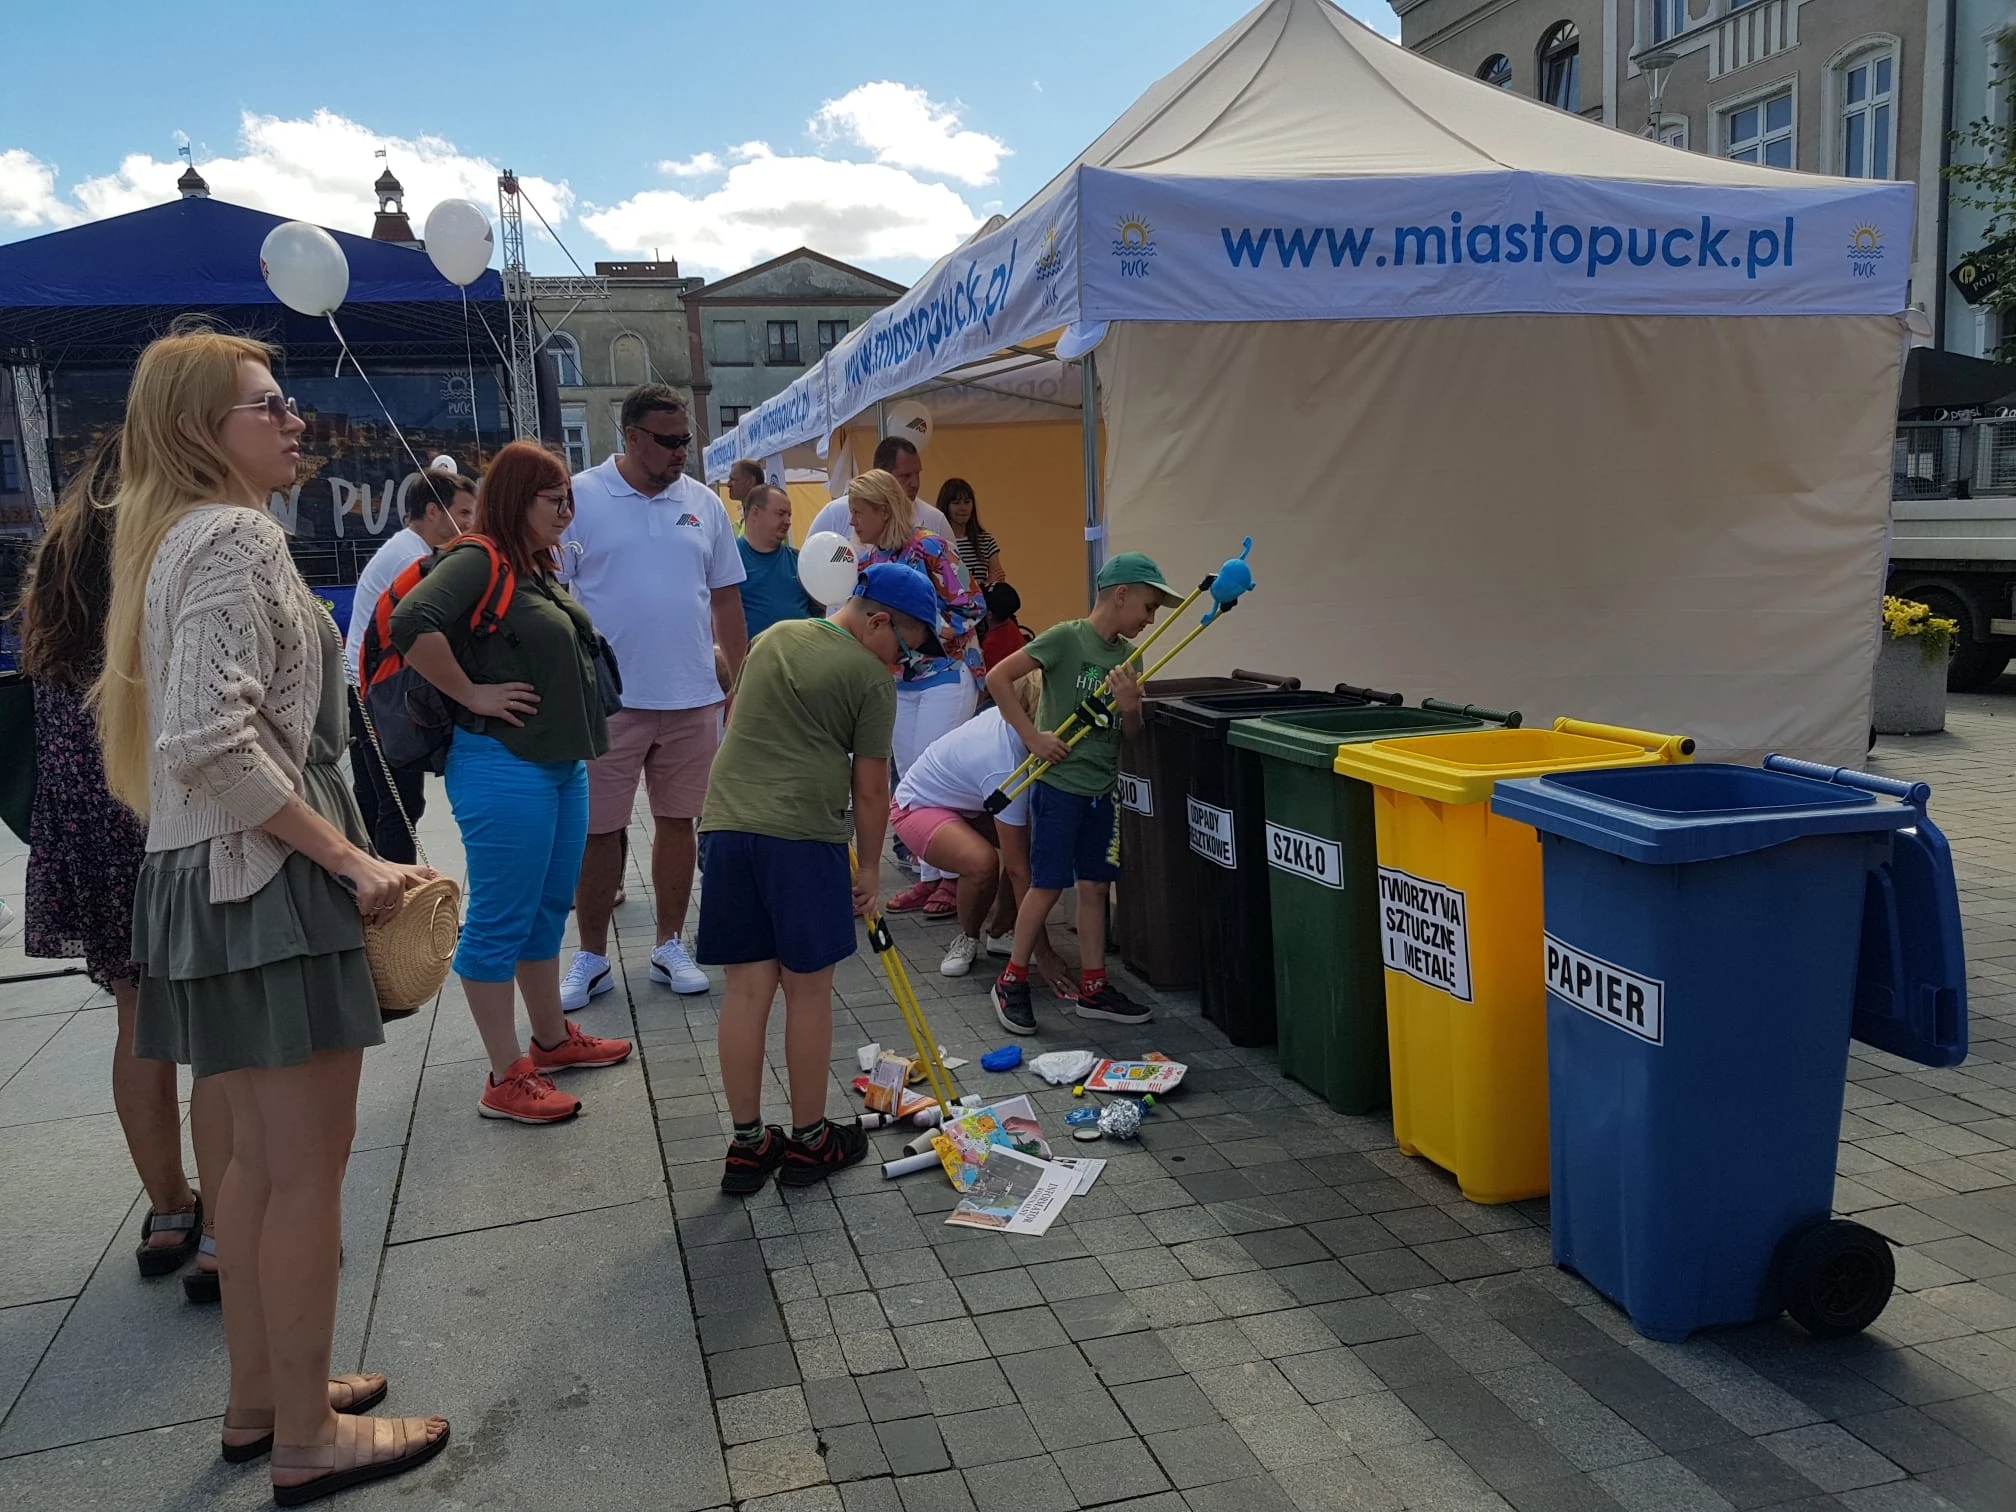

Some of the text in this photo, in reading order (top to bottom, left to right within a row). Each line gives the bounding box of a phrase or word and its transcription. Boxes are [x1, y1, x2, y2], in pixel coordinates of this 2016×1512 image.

[1120, 258, 1150, 279] PUCK
[1220, 210, 1795, 280] www.miastopuck.pl
[1852, 260, 1877, 279] PUCK
[843, 237, 1019, 394] www.miastopuck.pl
[447, 400, 473, 414] PUCK
[1119, 778, 1138, 805] BIO
[1190, 804, 1219, 833] ODPADY
[1273, 832, 1326, 876] SZKŁO
[1379, 874, 1461, 927] TWORZYWA
[1386, 906, 1457, 957] SZTUCZNE
[1389, 937, 1457, 989] I METALE
[1547, 944, 1646, 1028] PAPIER
